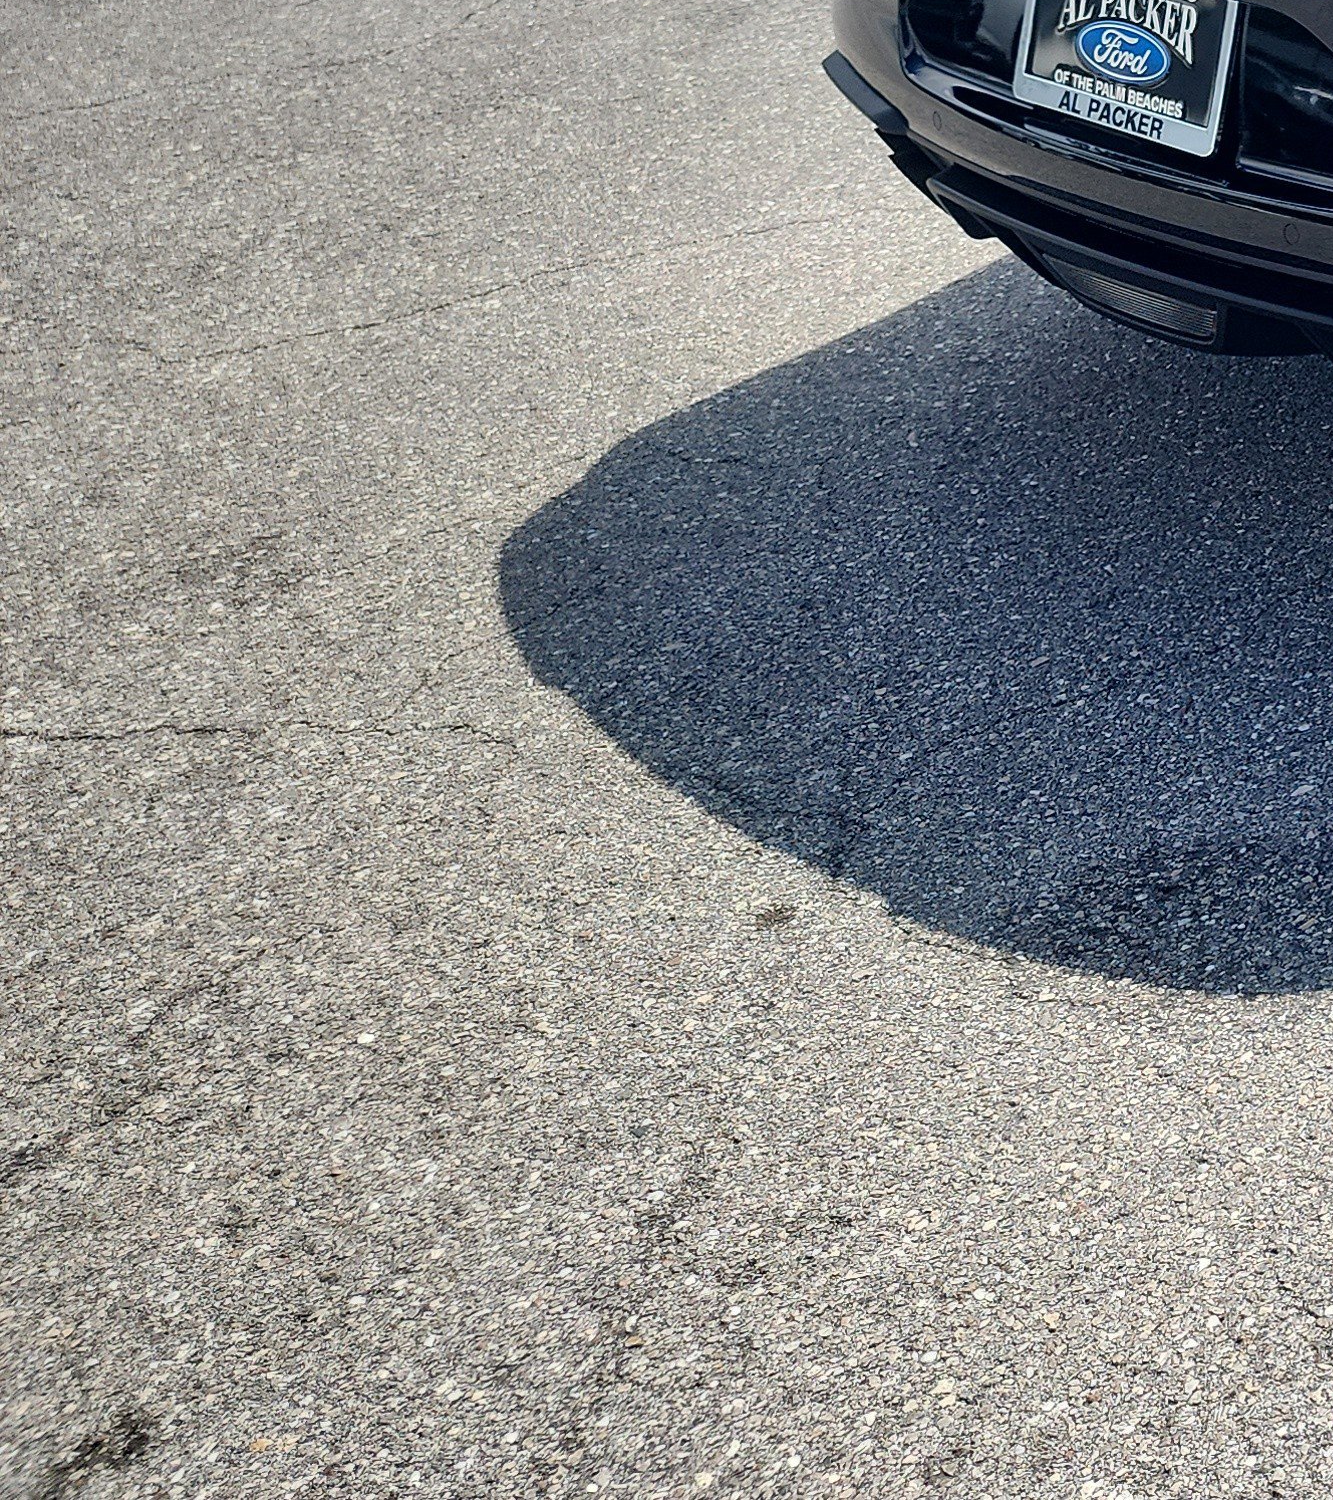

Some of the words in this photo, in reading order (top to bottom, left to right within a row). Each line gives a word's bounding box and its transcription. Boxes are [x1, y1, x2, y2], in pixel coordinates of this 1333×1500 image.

[1093, 29, 1149, 75] Ford
[1053, 69, 1071, 84] OF
[1071, 72, 1094, 92] THE
[1095, 79, 1127, 102] PALM
[1127, 89, 1184, 119] BEACHES
[1058, 90, 1082, 114] AL
[1087, 98, 1164, 140] PACKER
